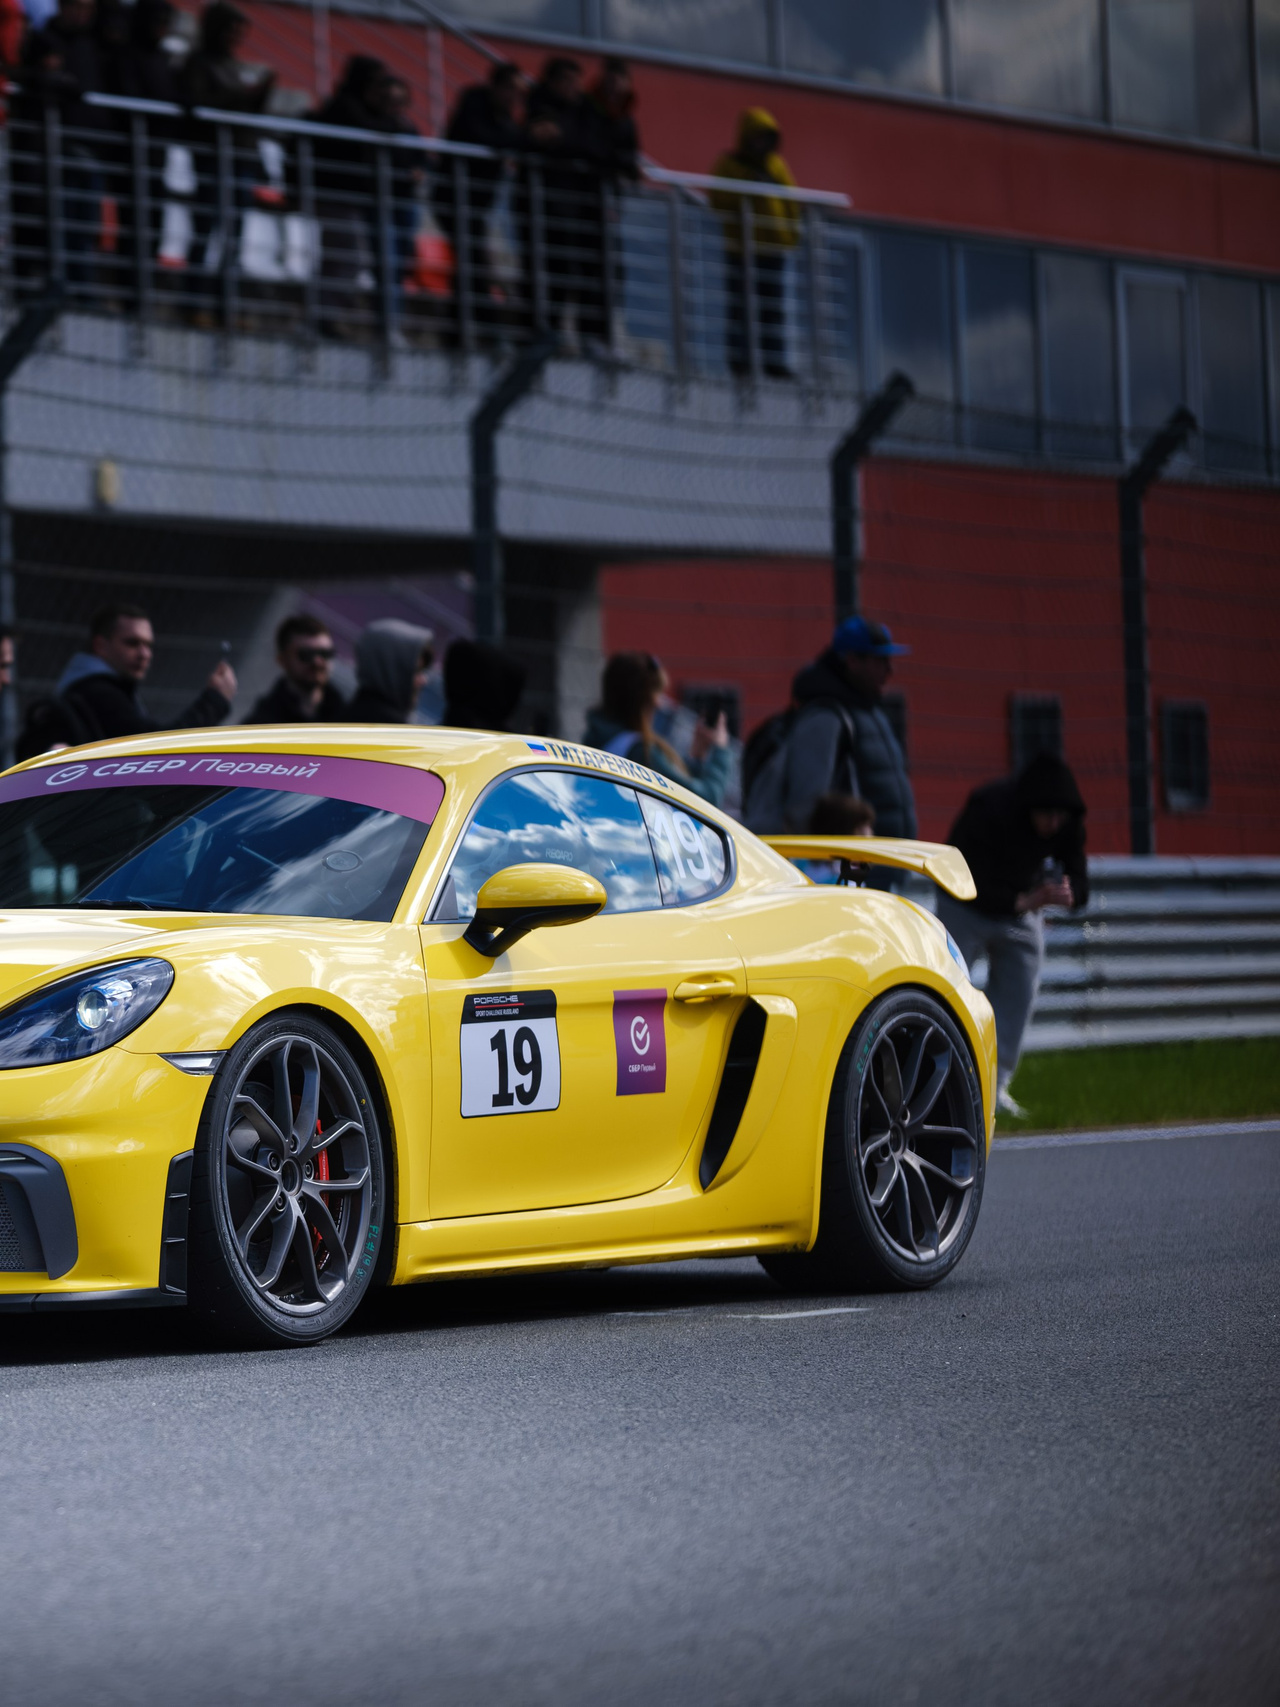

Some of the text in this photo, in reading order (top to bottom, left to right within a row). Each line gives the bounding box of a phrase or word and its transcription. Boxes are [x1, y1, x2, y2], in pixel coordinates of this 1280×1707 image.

[93, 758, 322, 779] СБЕР Первый
[544, 742, 652, 783] ТИТАРЕНКО
[653, 810, 712, 881] 19
[474, 995, 519, 1004] PORSCHE
[490, 1026, 542, 1108] 19
[628, 1064, 640, 1073] СБЕР
[368, 1224, 380, 1239] FL
